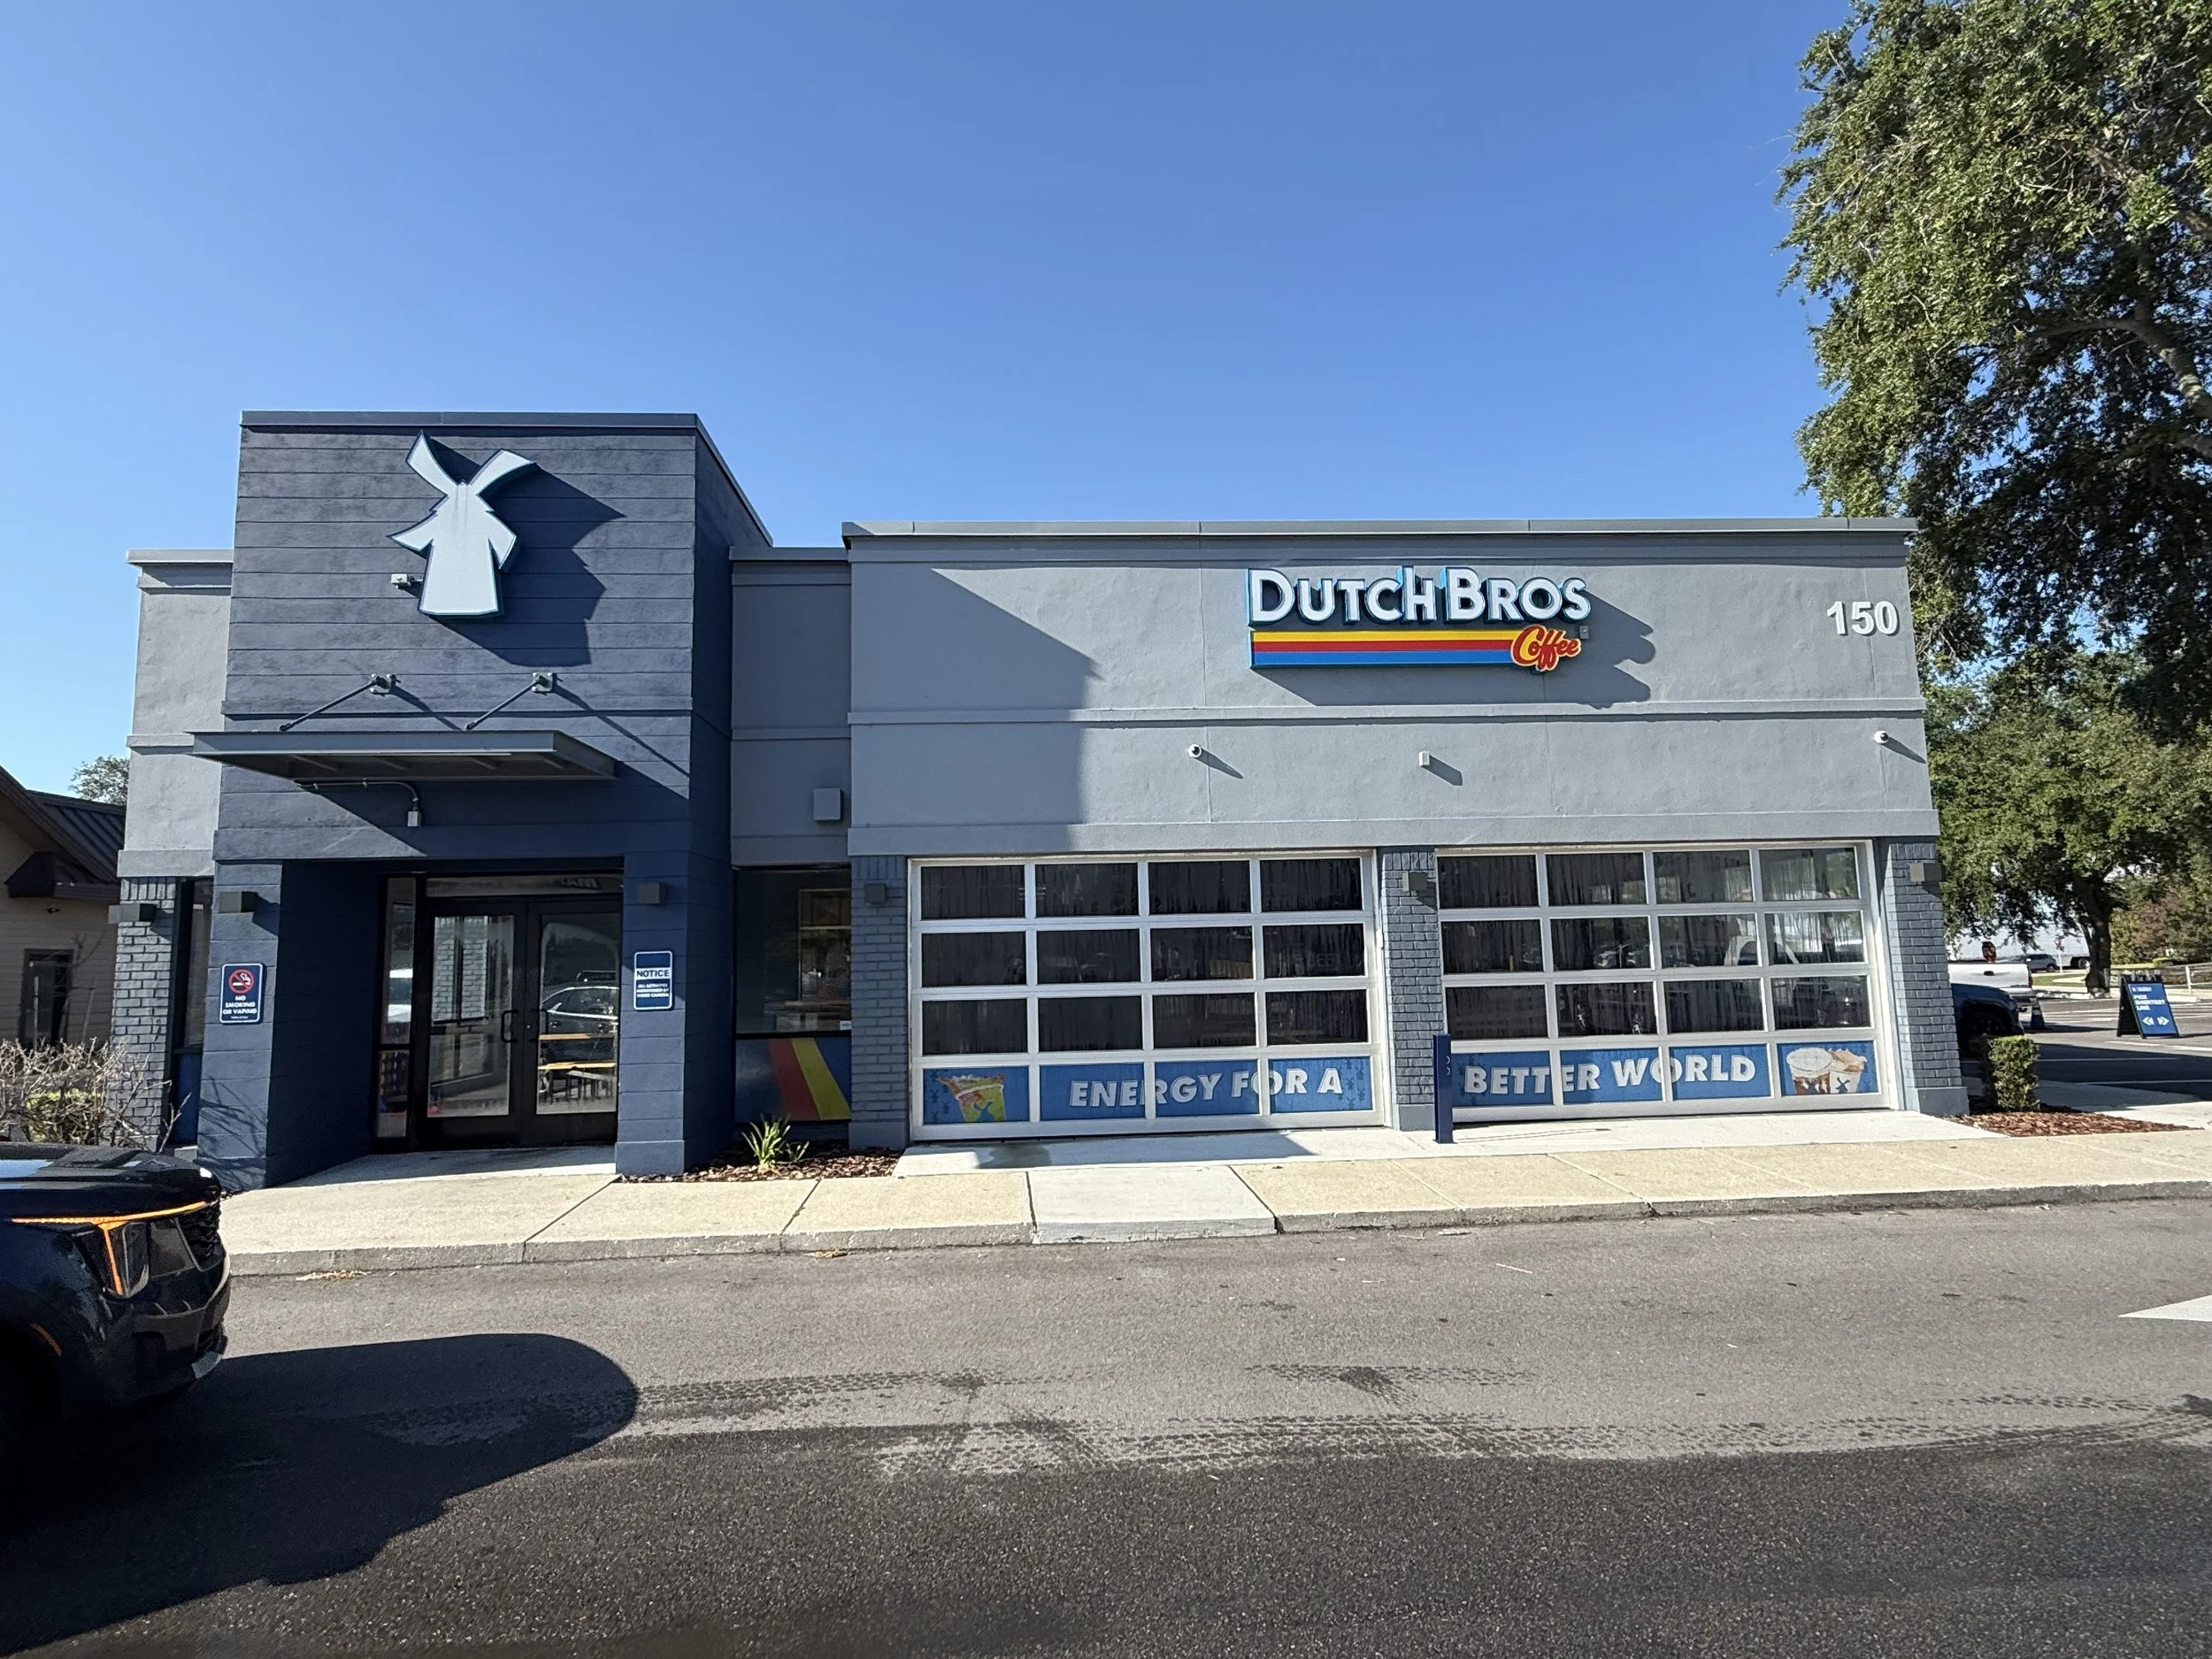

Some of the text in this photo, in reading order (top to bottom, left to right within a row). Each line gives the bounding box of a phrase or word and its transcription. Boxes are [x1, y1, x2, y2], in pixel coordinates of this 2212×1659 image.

[1827, 601, 1898, 634] 150
[1511, 625, 1581, 671] Coffee
[1070, 1067, 1343, 1107] ENERGY FOR A
[1464, 1053, 1756, 1094] BETTER WORLD
